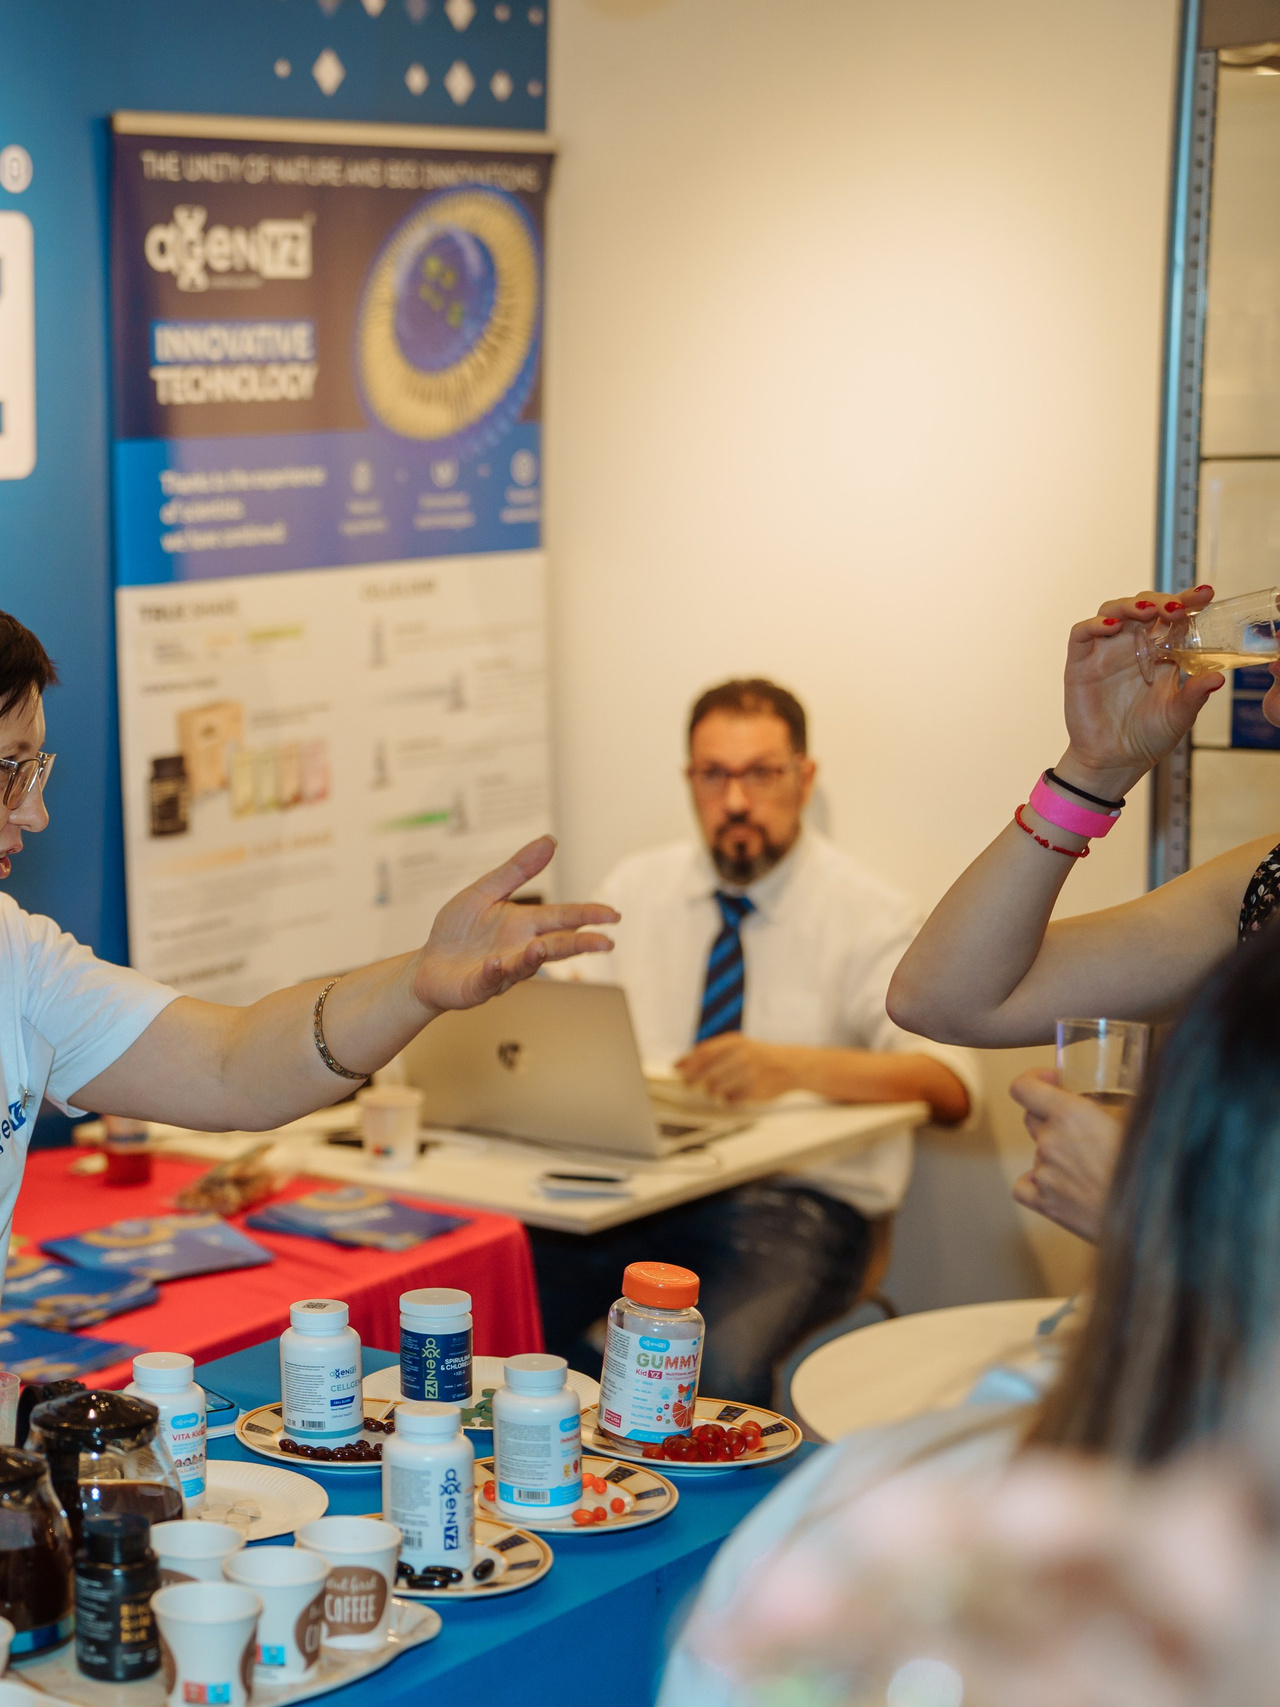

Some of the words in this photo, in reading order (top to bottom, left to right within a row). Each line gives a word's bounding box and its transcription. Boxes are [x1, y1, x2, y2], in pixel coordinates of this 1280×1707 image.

[140, 151, 183, 182] THE
[154, 323, 315, 363] INNOVATIVE
[149, 364, 319, 405] TECHNOLOGY
[444, 1354, 471, 1365] SPIRULIN
[636, 1352, 699, 1370] GUMMY
[172, 1433, 190, 1441] VITA
[324, 1594, 375, 1624] COFFEE
